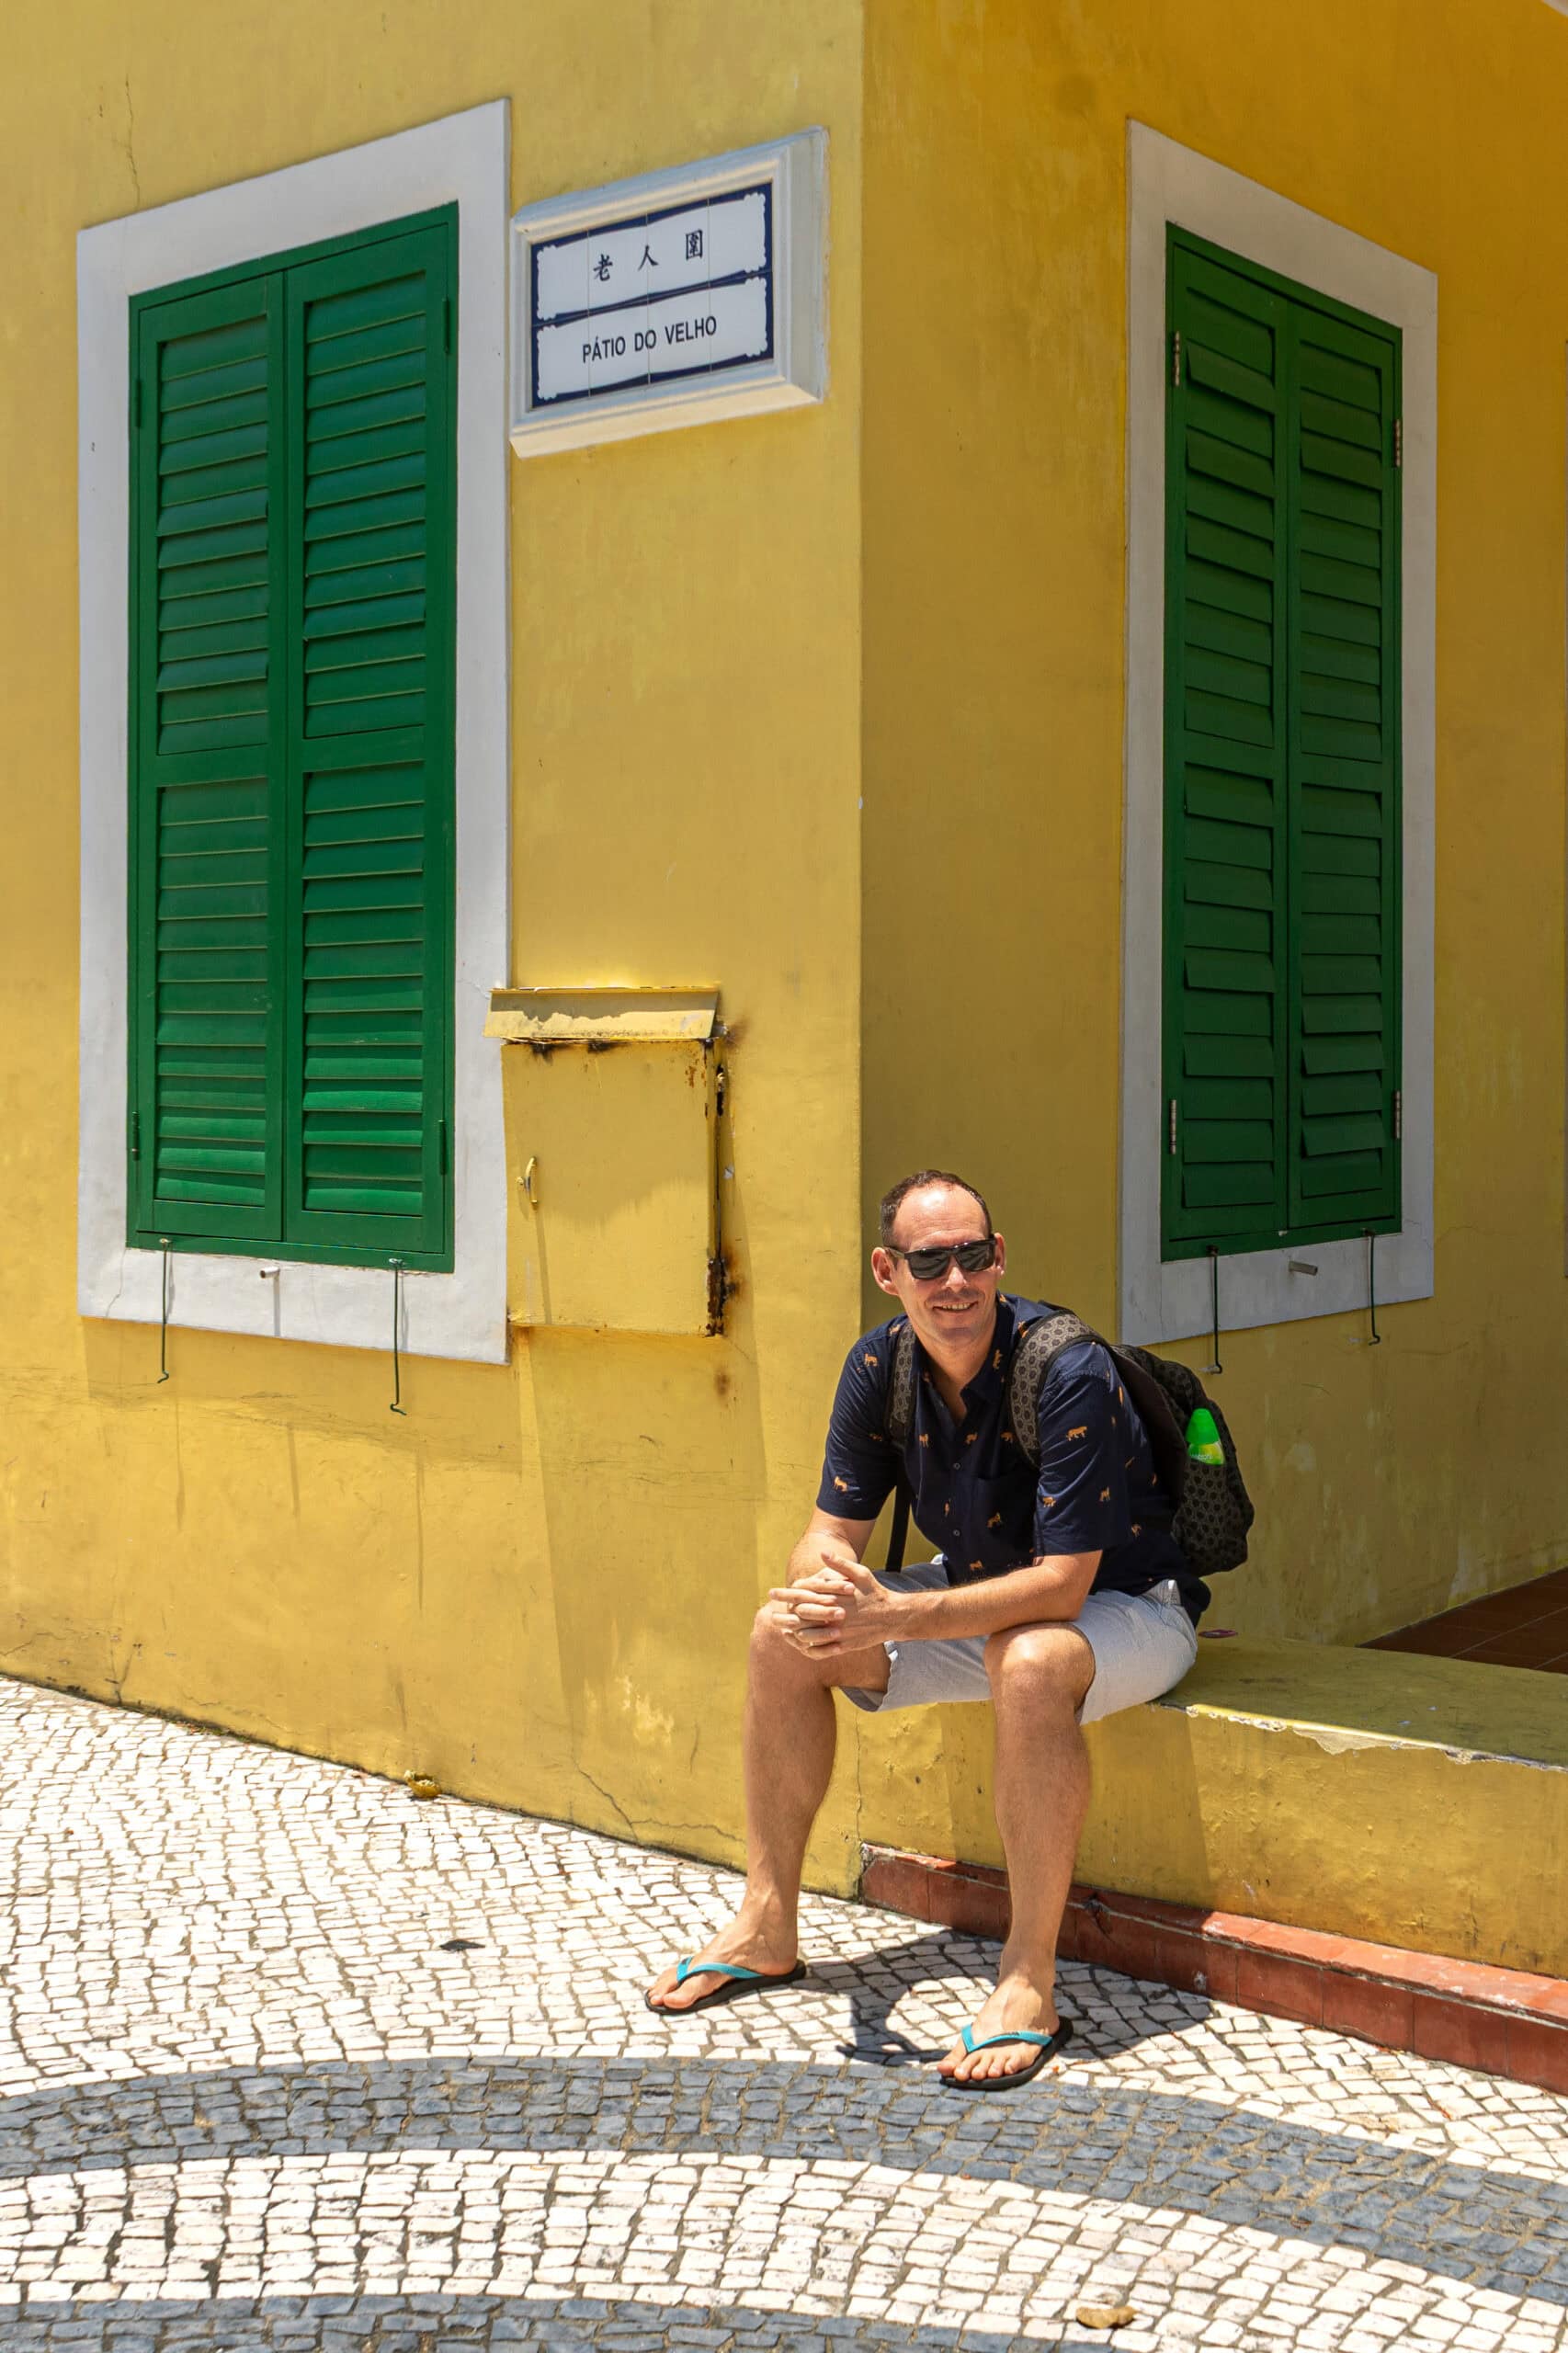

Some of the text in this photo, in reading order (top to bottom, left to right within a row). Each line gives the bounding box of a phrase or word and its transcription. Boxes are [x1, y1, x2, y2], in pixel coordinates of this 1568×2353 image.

[582, 315, 717, 363] PÁTIO DO VELHO
